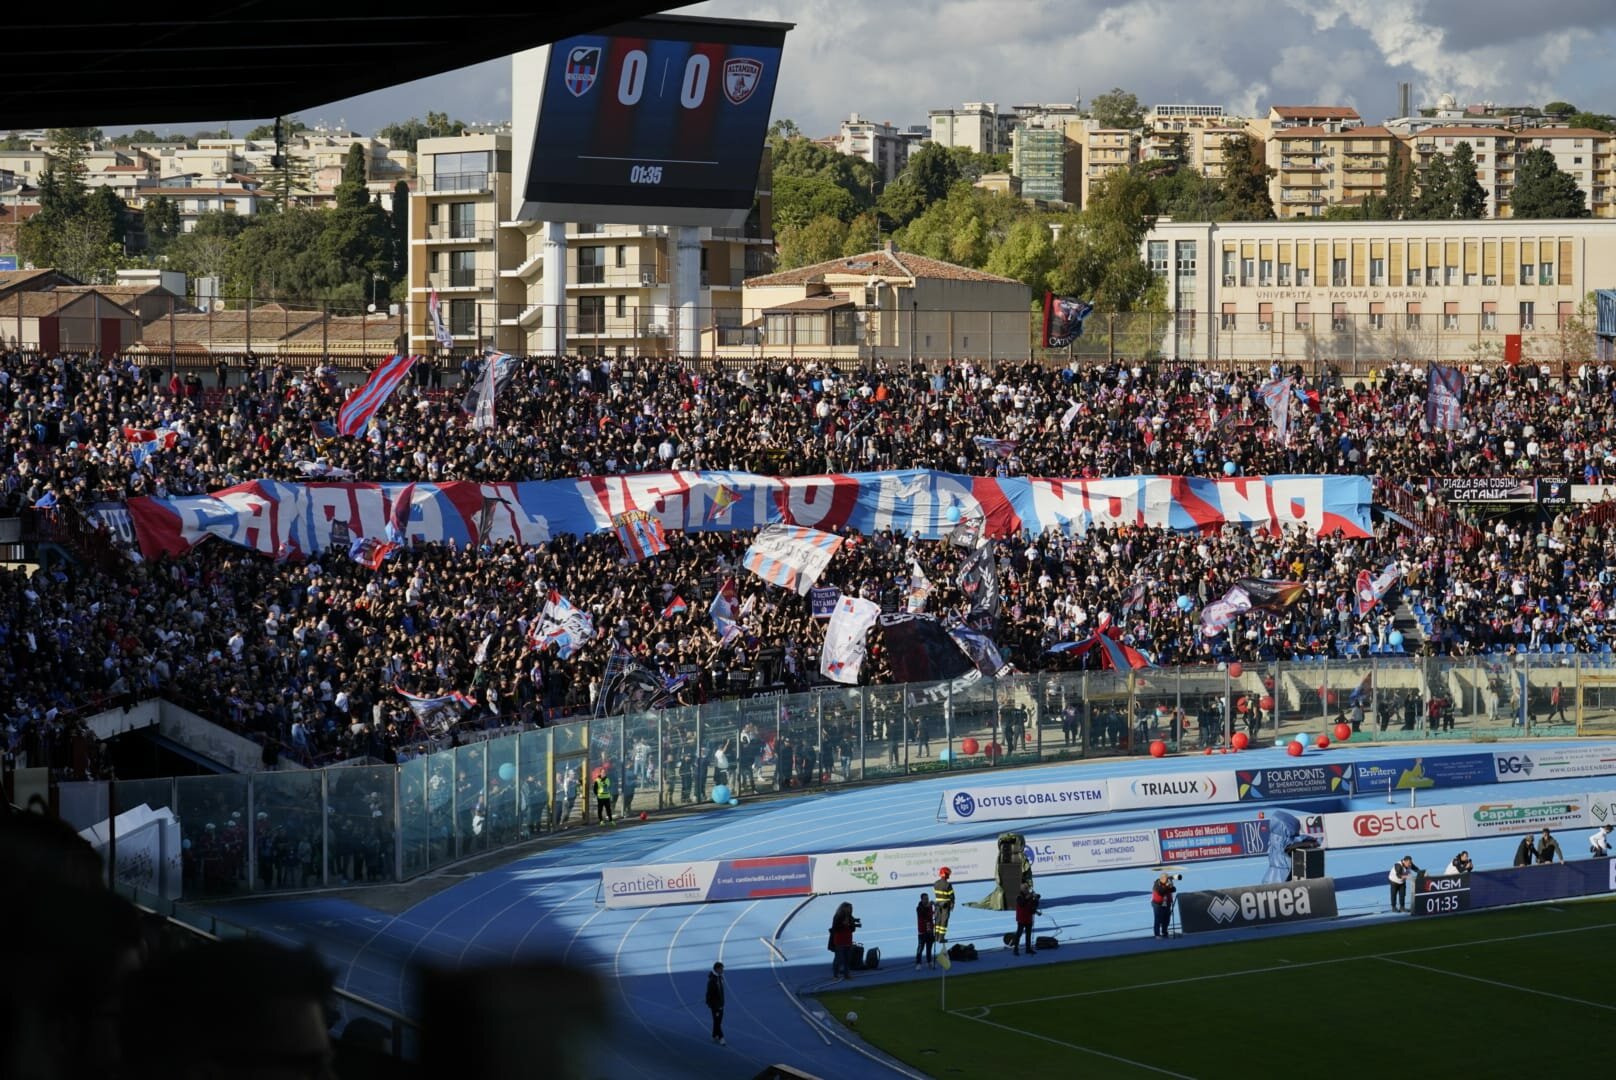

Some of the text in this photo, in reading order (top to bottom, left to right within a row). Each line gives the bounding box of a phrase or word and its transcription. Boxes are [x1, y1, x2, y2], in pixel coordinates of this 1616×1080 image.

[617, 50, 710, 109] 0 0
[630, 165, 663, 184] 01:35
[1385, 290, 1428, 299] AGRARIA
[1443, 478, 1471, 488] PIAZZA
[1473, 478, 1488, 488] SAN
[1454, 489, 1508, 499] CATANIA
[1032, 478, 1173, 538] NOI
[1217, 479, 1324, 538] NO
[1267, 768, 1325, 782] FOUR POINTS
[1141, 779, 1199, 796] TRIALUX
[977, 795, 1013, 808] LOTUS
[1014, 793, 1057, 805] GLOBAL
[1058, 790, 1102, 802] SYSTEM
[1479, 805, 1567, 822] Paper Service
[1354, 809, 1441, 836] restart
[1166, 830, 1174, 839] La
[1175, 828, 1194, 837] Scuola
[1204, 824, 1229, 835] Mestieri
[1035, 845, 1055, 855] L.C.
[611, 872, 697, 893] cantieri edili
[1427, 879, 1461, 891] NGM
[1426, 895, 1459, 912] 01:35
